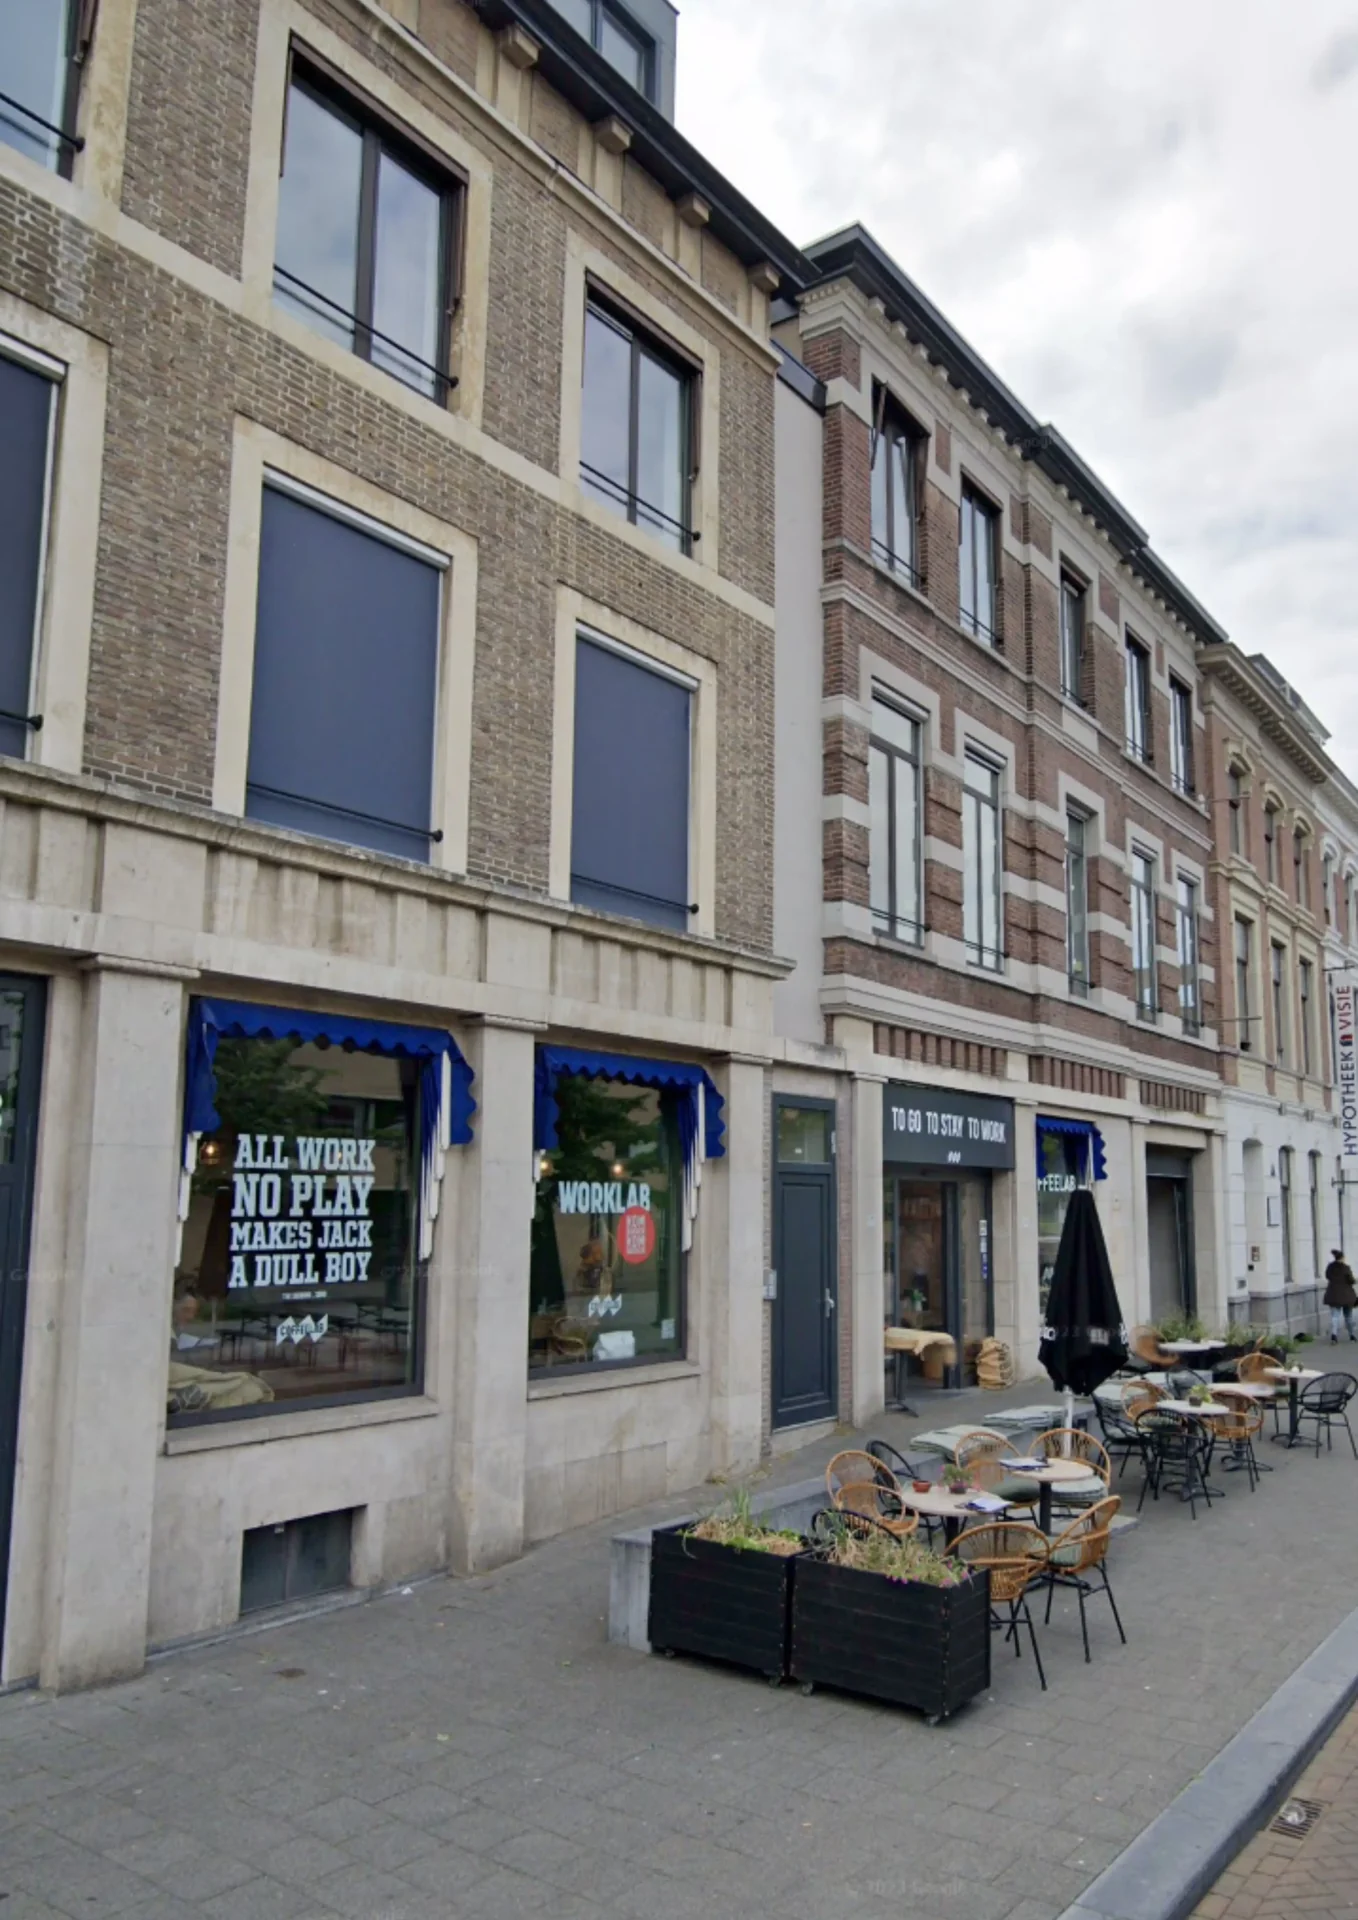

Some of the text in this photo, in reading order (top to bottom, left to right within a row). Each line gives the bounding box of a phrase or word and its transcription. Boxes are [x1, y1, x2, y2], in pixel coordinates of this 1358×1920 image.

[1336, 985, 1357, 1157] HYPOTHEEK VISIE
[891, 1106, 1006, 1144] TO GO TO STAY TO WORK
[233, 1133, 376, 1172] ALL WORK
[231, 1173, 375, 1217] NO PLAY
[558, 1180, 650, 1214] WORKLAB
[229, 1220, 373, 1251] MAKES JACK
[228, 1255, 248, 1289] A
[254, 1253, 319, 1287] DULL
[325, 1251, 372, 1283] BOY
